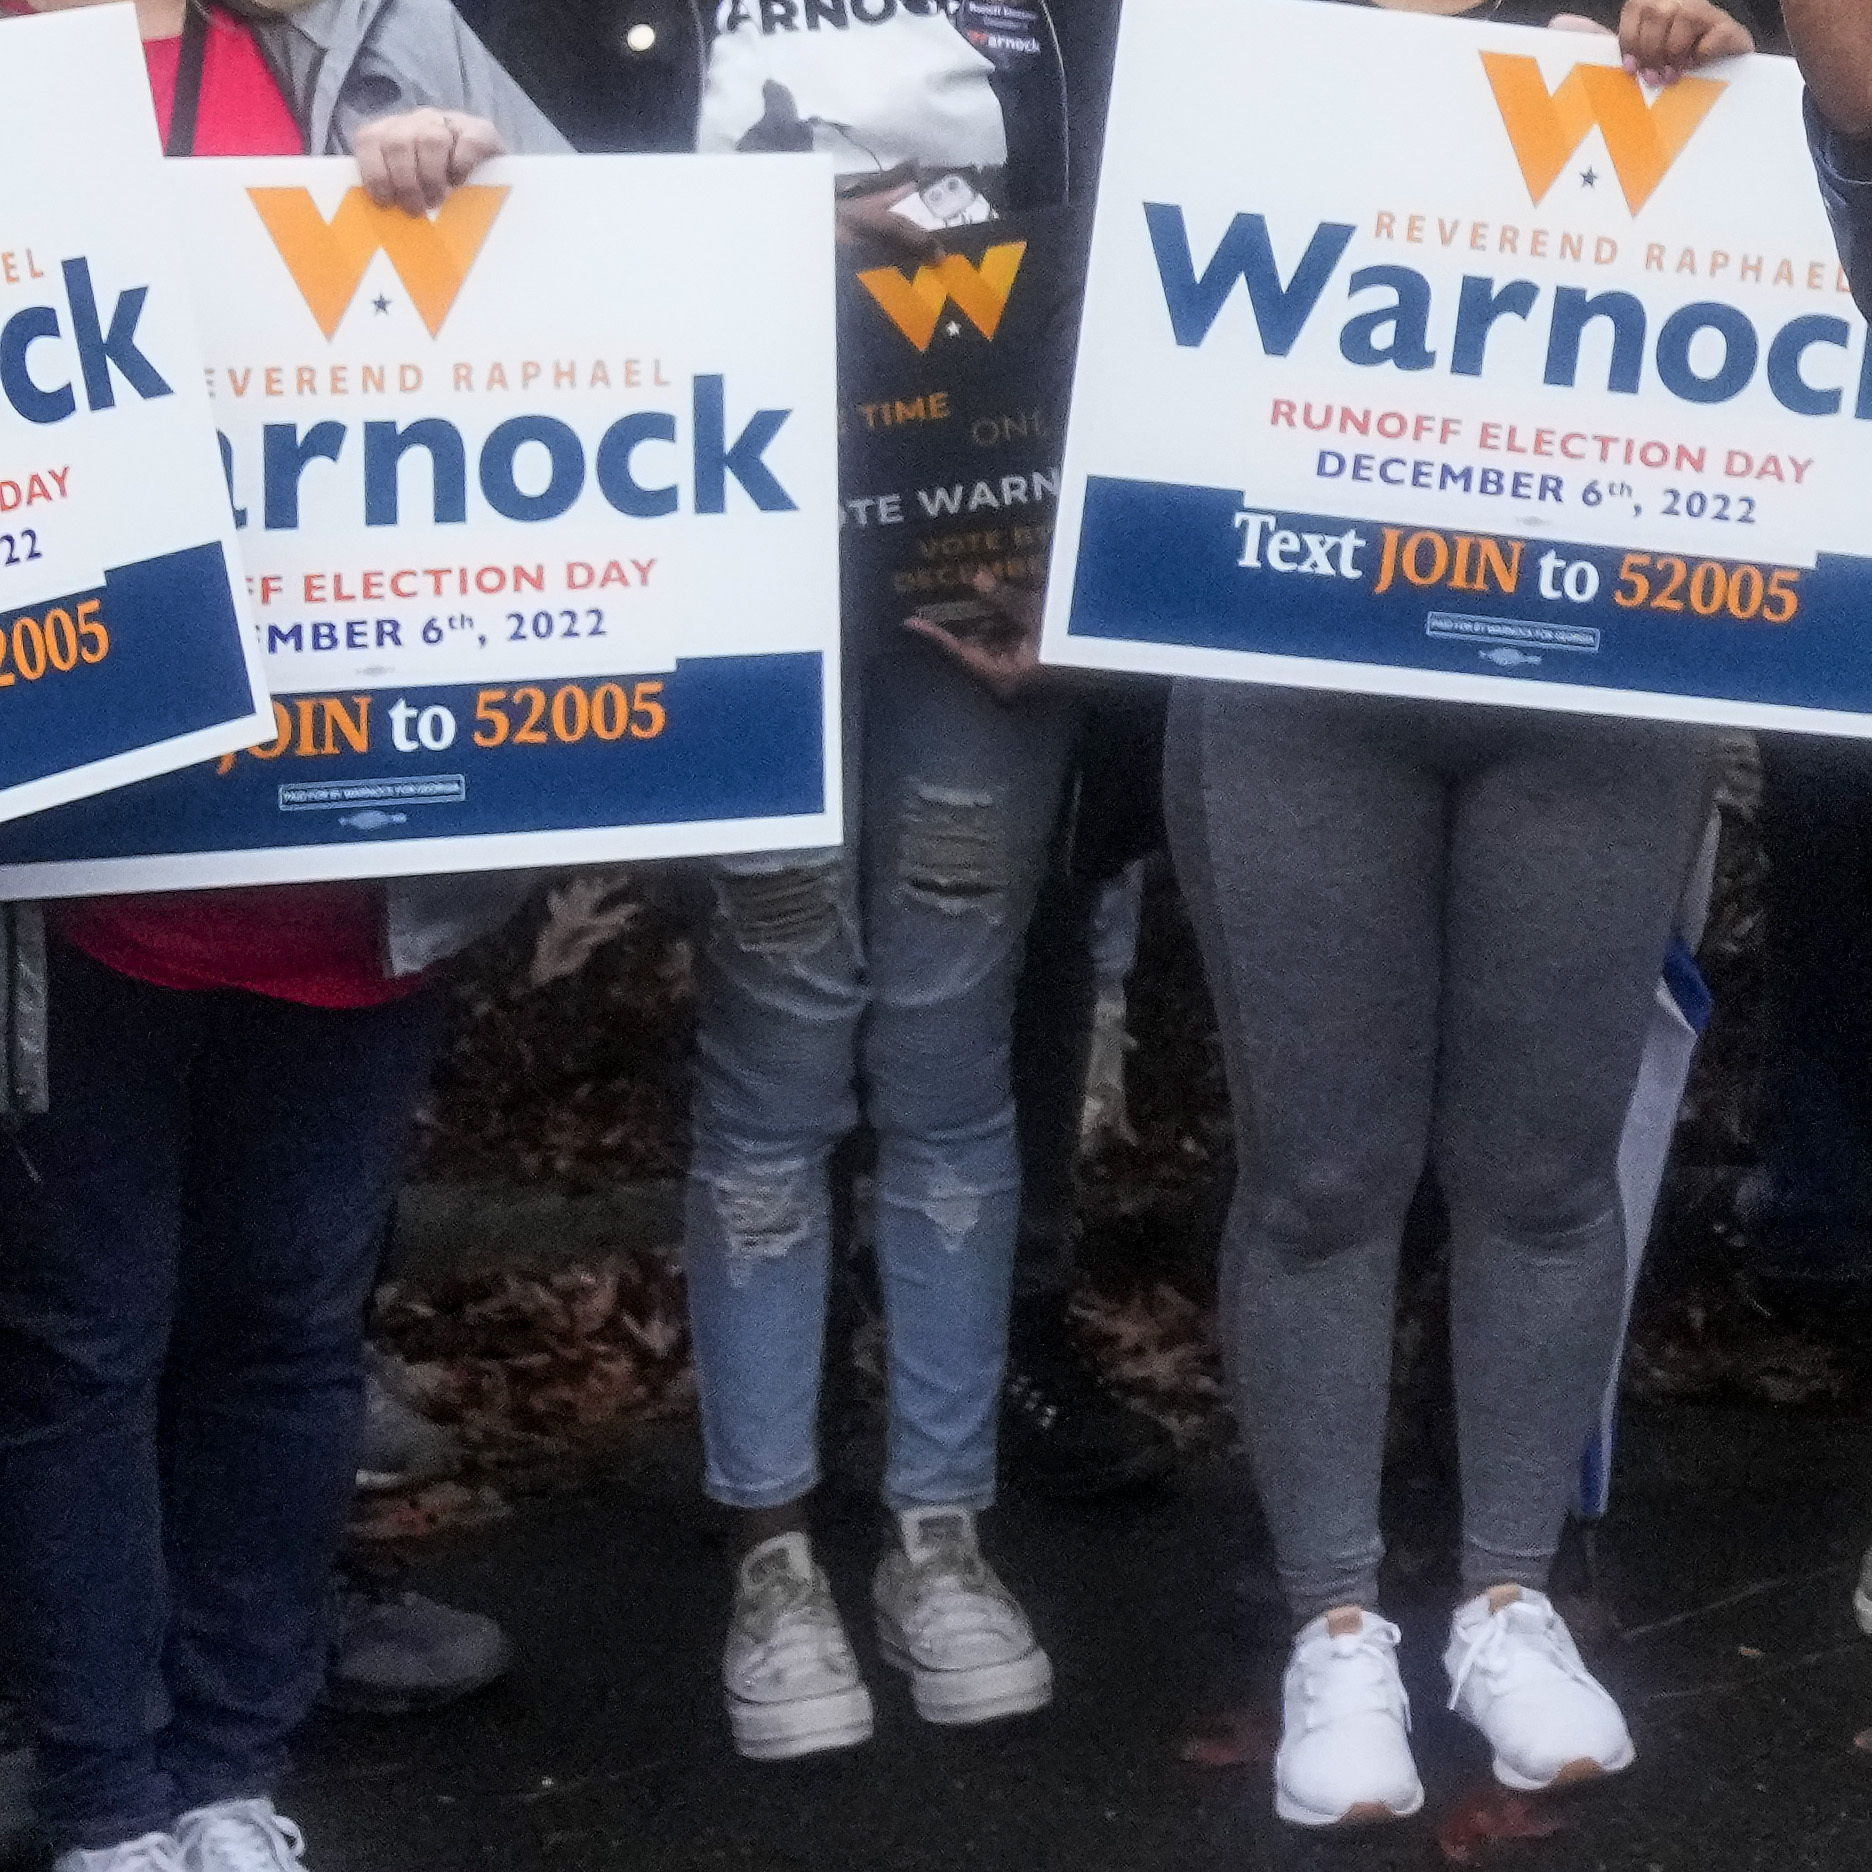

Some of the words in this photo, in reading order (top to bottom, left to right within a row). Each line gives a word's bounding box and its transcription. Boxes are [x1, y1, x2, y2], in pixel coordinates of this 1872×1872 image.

[1374, 209, 1620, 267] REVEREND
[207, 364, 426, 397] VEREND
[453, 357, 674, 393] RAPHAEL
[862, 392, 952, 428] TIME
[216, 374, 800, 532] rnock
[1270, 397, 1463, 448] RUNOFF
[1479, 420, 1709, 474] ELECTION
[1722, 448, 1815, 486] DAY
[839, 494, 903, 526] TE
[918, 467, 1060, 519] WARN
[1315, 448, 1566, 505] DECEMBER
[1580, 473, 1643, 518] 6th,
[1660, 487, 1758, 525] 2022
[2, 529, 43, 566] 22
[1233, 509, 1367, 582] Text
[1374, 526, 1526, 596] JOIN
[1538, 550, 1600, 605] to
[1614, 553, 1801, 625] 52005
[304, 563, 547, 605] ELECTION
[565, 558, 660, 594] DAY
[0, 600, 110, 687] 005
[256, 617, 404, 655] MBER
[420, 614, 488, 650] 6th,
[506, 608, 609, 642] 2022
[216, 694, 372, 776] OIN
[389, 697, 457, 750] to
[473, 679, 668, 748] 52005
